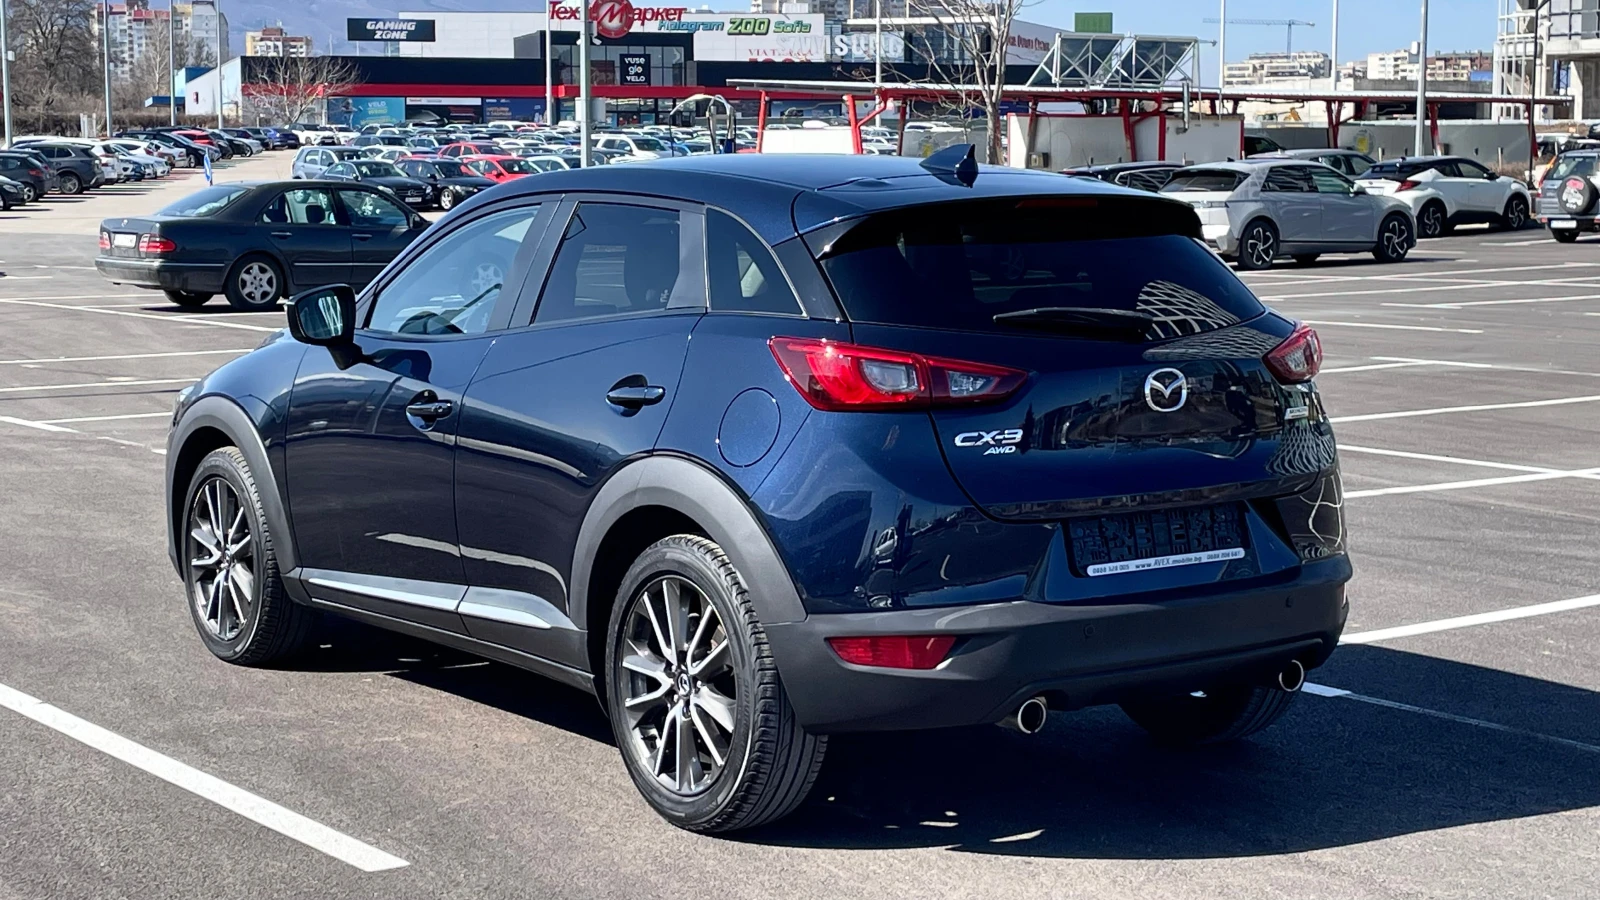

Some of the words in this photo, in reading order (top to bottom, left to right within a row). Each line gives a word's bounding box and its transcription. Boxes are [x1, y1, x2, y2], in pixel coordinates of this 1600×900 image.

[366, 21, 416, 30] GAMING
[658, 20, 725, 33] Hologram
[727, 18, 770, 36] ZOO
[773, 20, 811, 33] Sofia
[374, 31, 408, 39] ZONE
[628, 65, 643, 75] glo
[954, 428, 1023, 447] CX-3
[983, 445, 1016, 456] AWD
